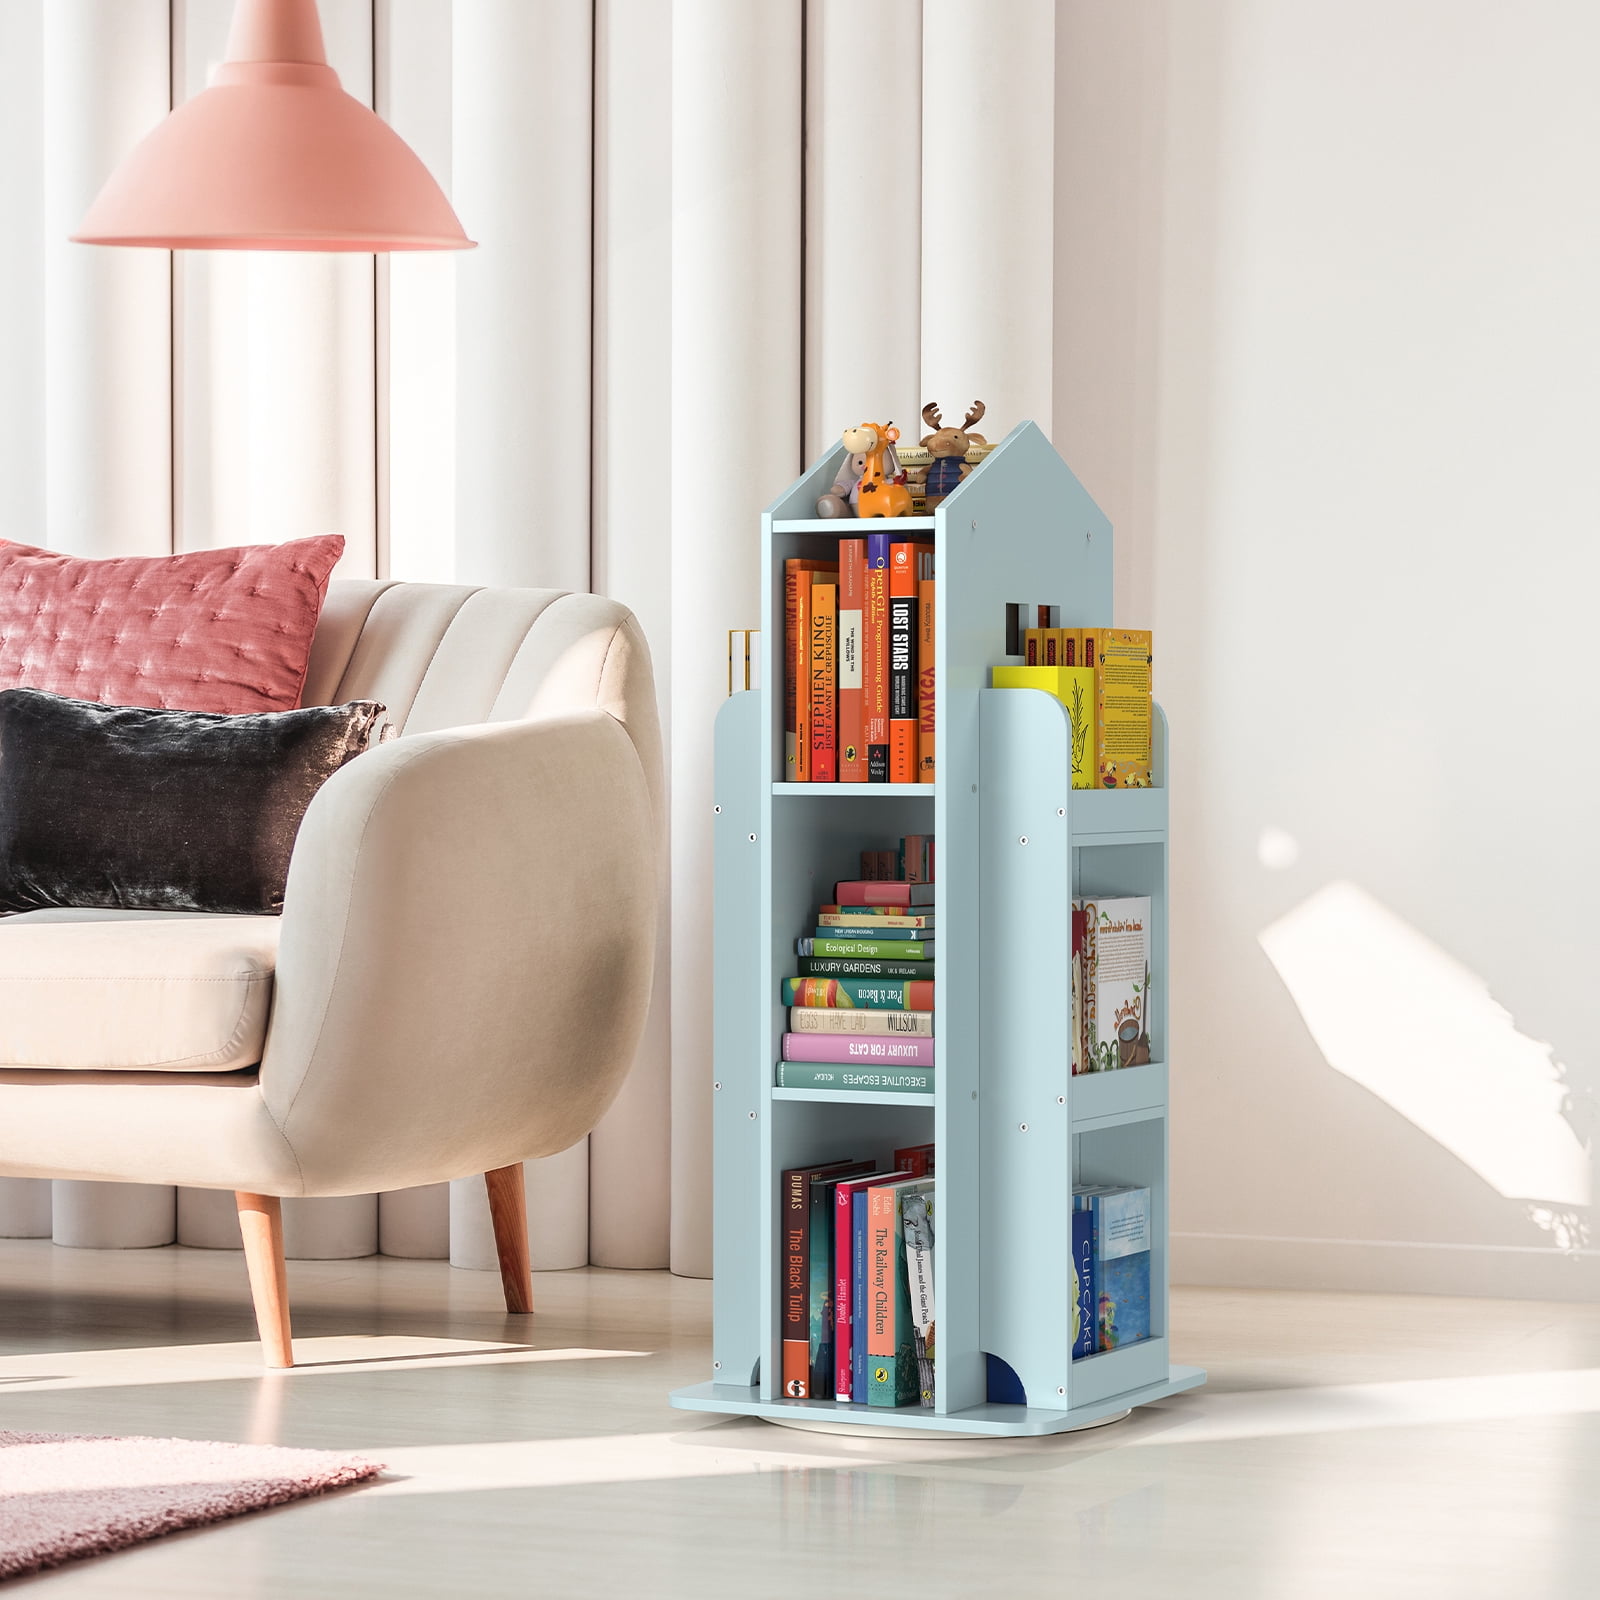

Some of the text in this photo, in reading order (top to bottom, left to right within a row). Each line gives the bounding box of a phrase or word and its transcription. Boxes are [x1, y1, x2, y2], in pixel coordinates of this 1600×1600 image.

[892, 603, 909, 670] LOST STARS
[875, 620, 883, 682] Programming
[813, 616, 825, 750] STEPHEN KING
[825, 676, 832, 686] LE
[876, 685, 884, 713] Guide
[825, 723, 834, 750] JUSTE
[825, 943, 878, 955] Ecological Design
[810, 962, 841, 972] LUXURY
[843, 963, 881, 973] GARDENS
[898, 967, 916, 975] IRELAND
[858, 988, 902, 1004] Pear & Bacon
[800, 1011, 818, 1029] EGGS
[829, 1012, 847, 1030] HAVE
[887, 1013, 918, 1032] WILLSON
[849, 1042, 918, 1057] LUXURY FOR CATS
[813, 1073, 927, 1087] EXECUTIVE ESCAPES HOLIDAY
[791, 1175, 802, 1210] DUMAS
[872, 1194, 881, 1216] Nesbit
[883, 1196, 892, 1214] Edith
[787, 1228, 803, 1322] The Black Tulip
[916, 1258, 924, 1273] James
[873, 1228, 888, 1335] The Railway Children
[918, 1274, 926, 1284] and
[919, 1285, 927, 1293] the
[1081, 1239, 1092, 1356] CUPCAKE
[837, 1278, 847, 1324] Double Hamlet
[920, 1293, 928, 1308] Giant
[921, 1309, 929, 1325] Peach
